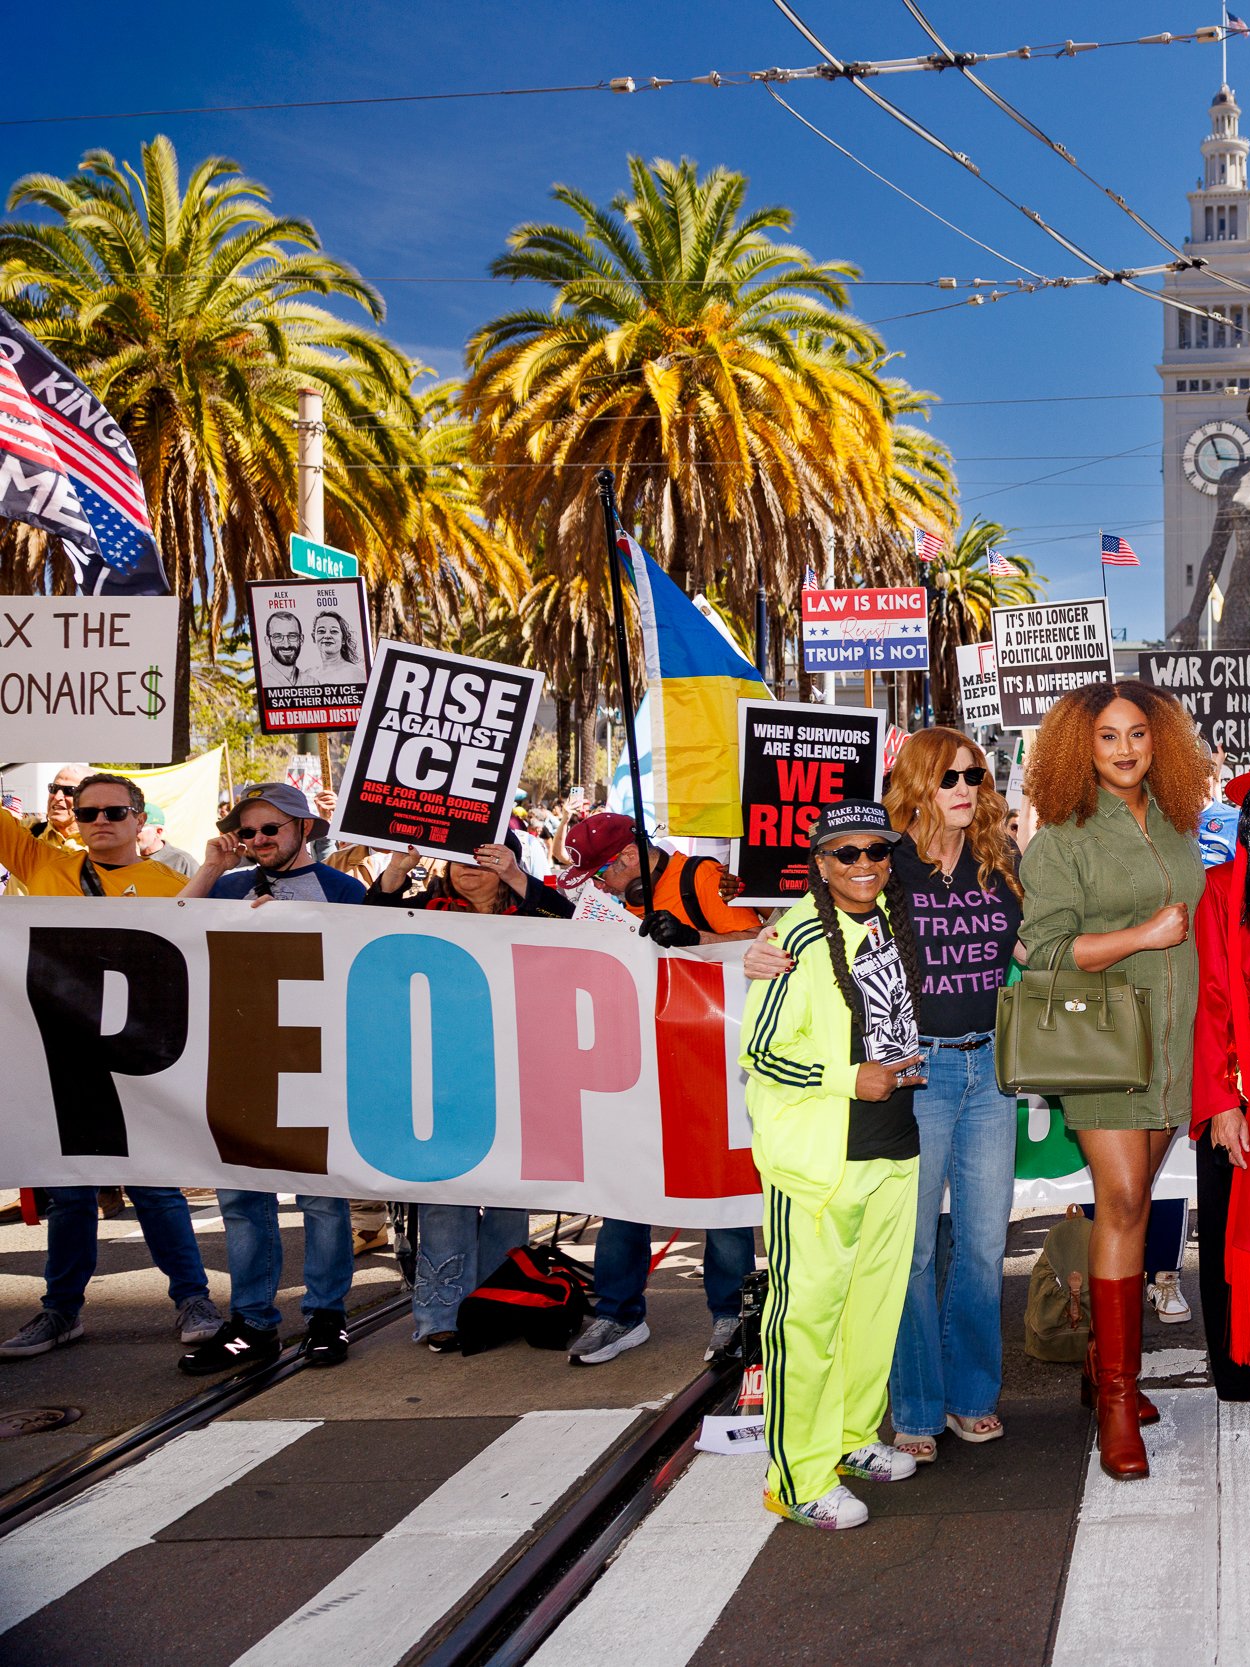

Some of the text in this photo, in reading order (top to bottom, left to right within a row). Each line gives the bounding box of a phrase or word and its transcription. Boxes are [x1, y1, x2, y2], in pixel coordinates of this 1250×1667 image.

[306, 548, 344, 577] Market
[269, 599, 296, 609] PRETTI
[317, 597, 338, 607] GOOD
[807, 593, 921, 612] LAW IS KING
[1006, 606, 1089, 629] IT'S NO LONGER
[53, 612, 131, 648] THE
[1005, 624, 1096, 646] A DIFFERENCE IN
[805, 644, 926, 662] TRUMP IS NOT
[1001, 642, 1104, 664] POLITICAL OPINION
[1150, 656, 1204, 688] WAR
[0, 665, 166, 720] ONAIRE$
[268, 685, 363, 698] MURDERED BY ICE...
[963, 685, 997, 700] DEPO
[1003, 674, 1024, 694] IT'S
[1026, 675, 1035, 692] A
[272, 696, 362, 708] SAY THEIR NAMES.
[385, 659, 522, 732] RISE
[1019, 697, 1032, 715] IN
[1174, 692, 1213, 715] N'T
[268, 711, 285, 726] WE
[286, 709, 327, 725] DEMAND
[965, 703, 1000, 720] KIDN
[378, 709, 510, 751] AGAINST
[753, 723, 870, 745] WHEN SURVIVORS
[763, 741, 860, 763] ARE SILENCED,
[365, 728, 506, 803] ICE
[776, 759, 845, 803] WE
[360, 791, 490, 824] OUR EARTH, OUR FUTURE
[362, 780, 491, 815] RISE FOR OUR BODIES,
[827, 805, 885, 819] MAKE RACISM
[828, 814, 860, 827] WRONG
[748, 803, 822, 848] RIS
[785, 879, 804, 890] VDAY
[913, 887, 1002, 908] BLACK
[913, 912, 1009, 938] TRANS
[925, 941, 999, 965] LIVES
[27, 926, 763, 1199] PEOPL
